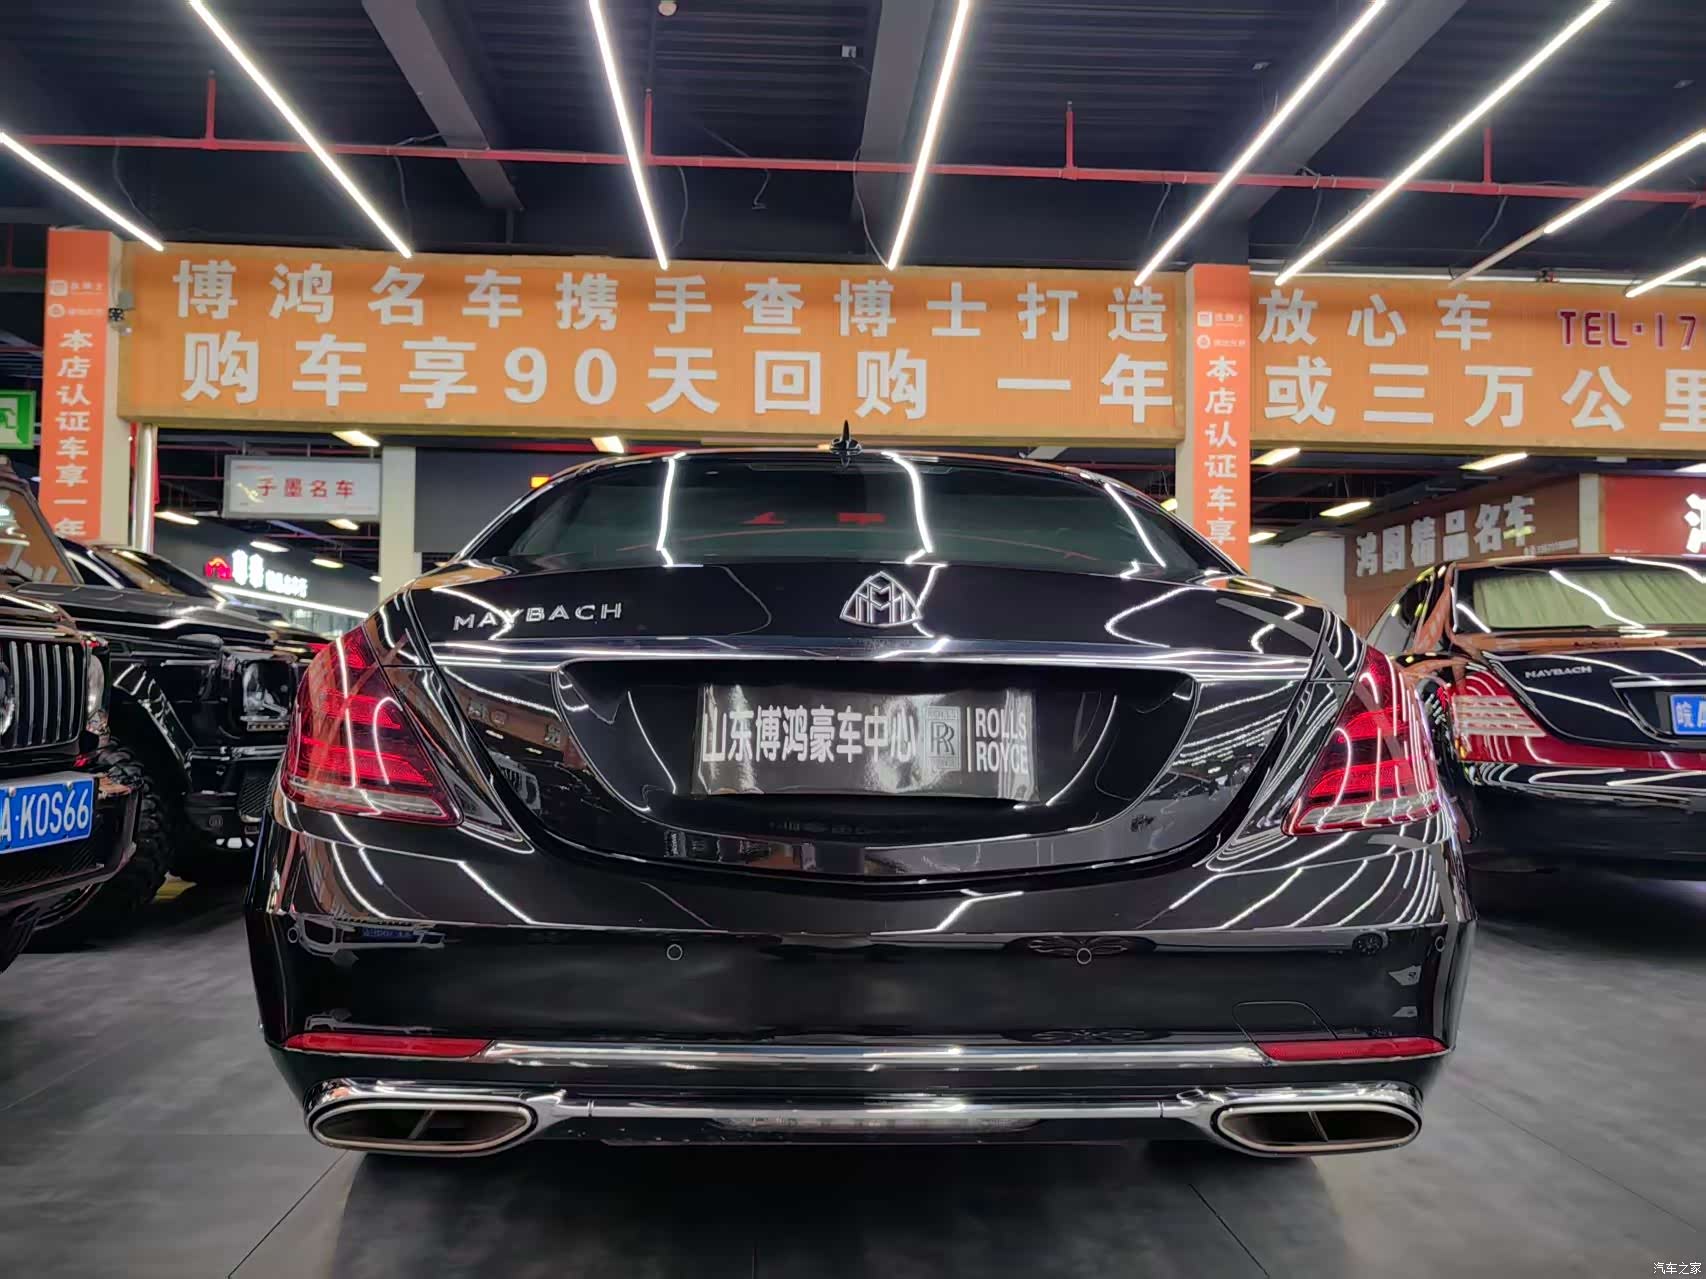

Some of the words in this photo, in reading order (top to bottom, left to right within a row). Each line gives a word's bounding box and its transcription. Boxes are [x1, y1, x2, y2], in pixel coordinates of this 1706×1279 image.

[1257, 288, 1493, 351] 放心车
[452, 602, 623, 631] MAYBACH
[1524, 664, 1593, 679] MAYBACH
[701, 703, 917, 763] 山东博鸿豪车中心
[975, 707, 1028, 740] ROLLS
[975, 740, 1029, 774] ROYCE
